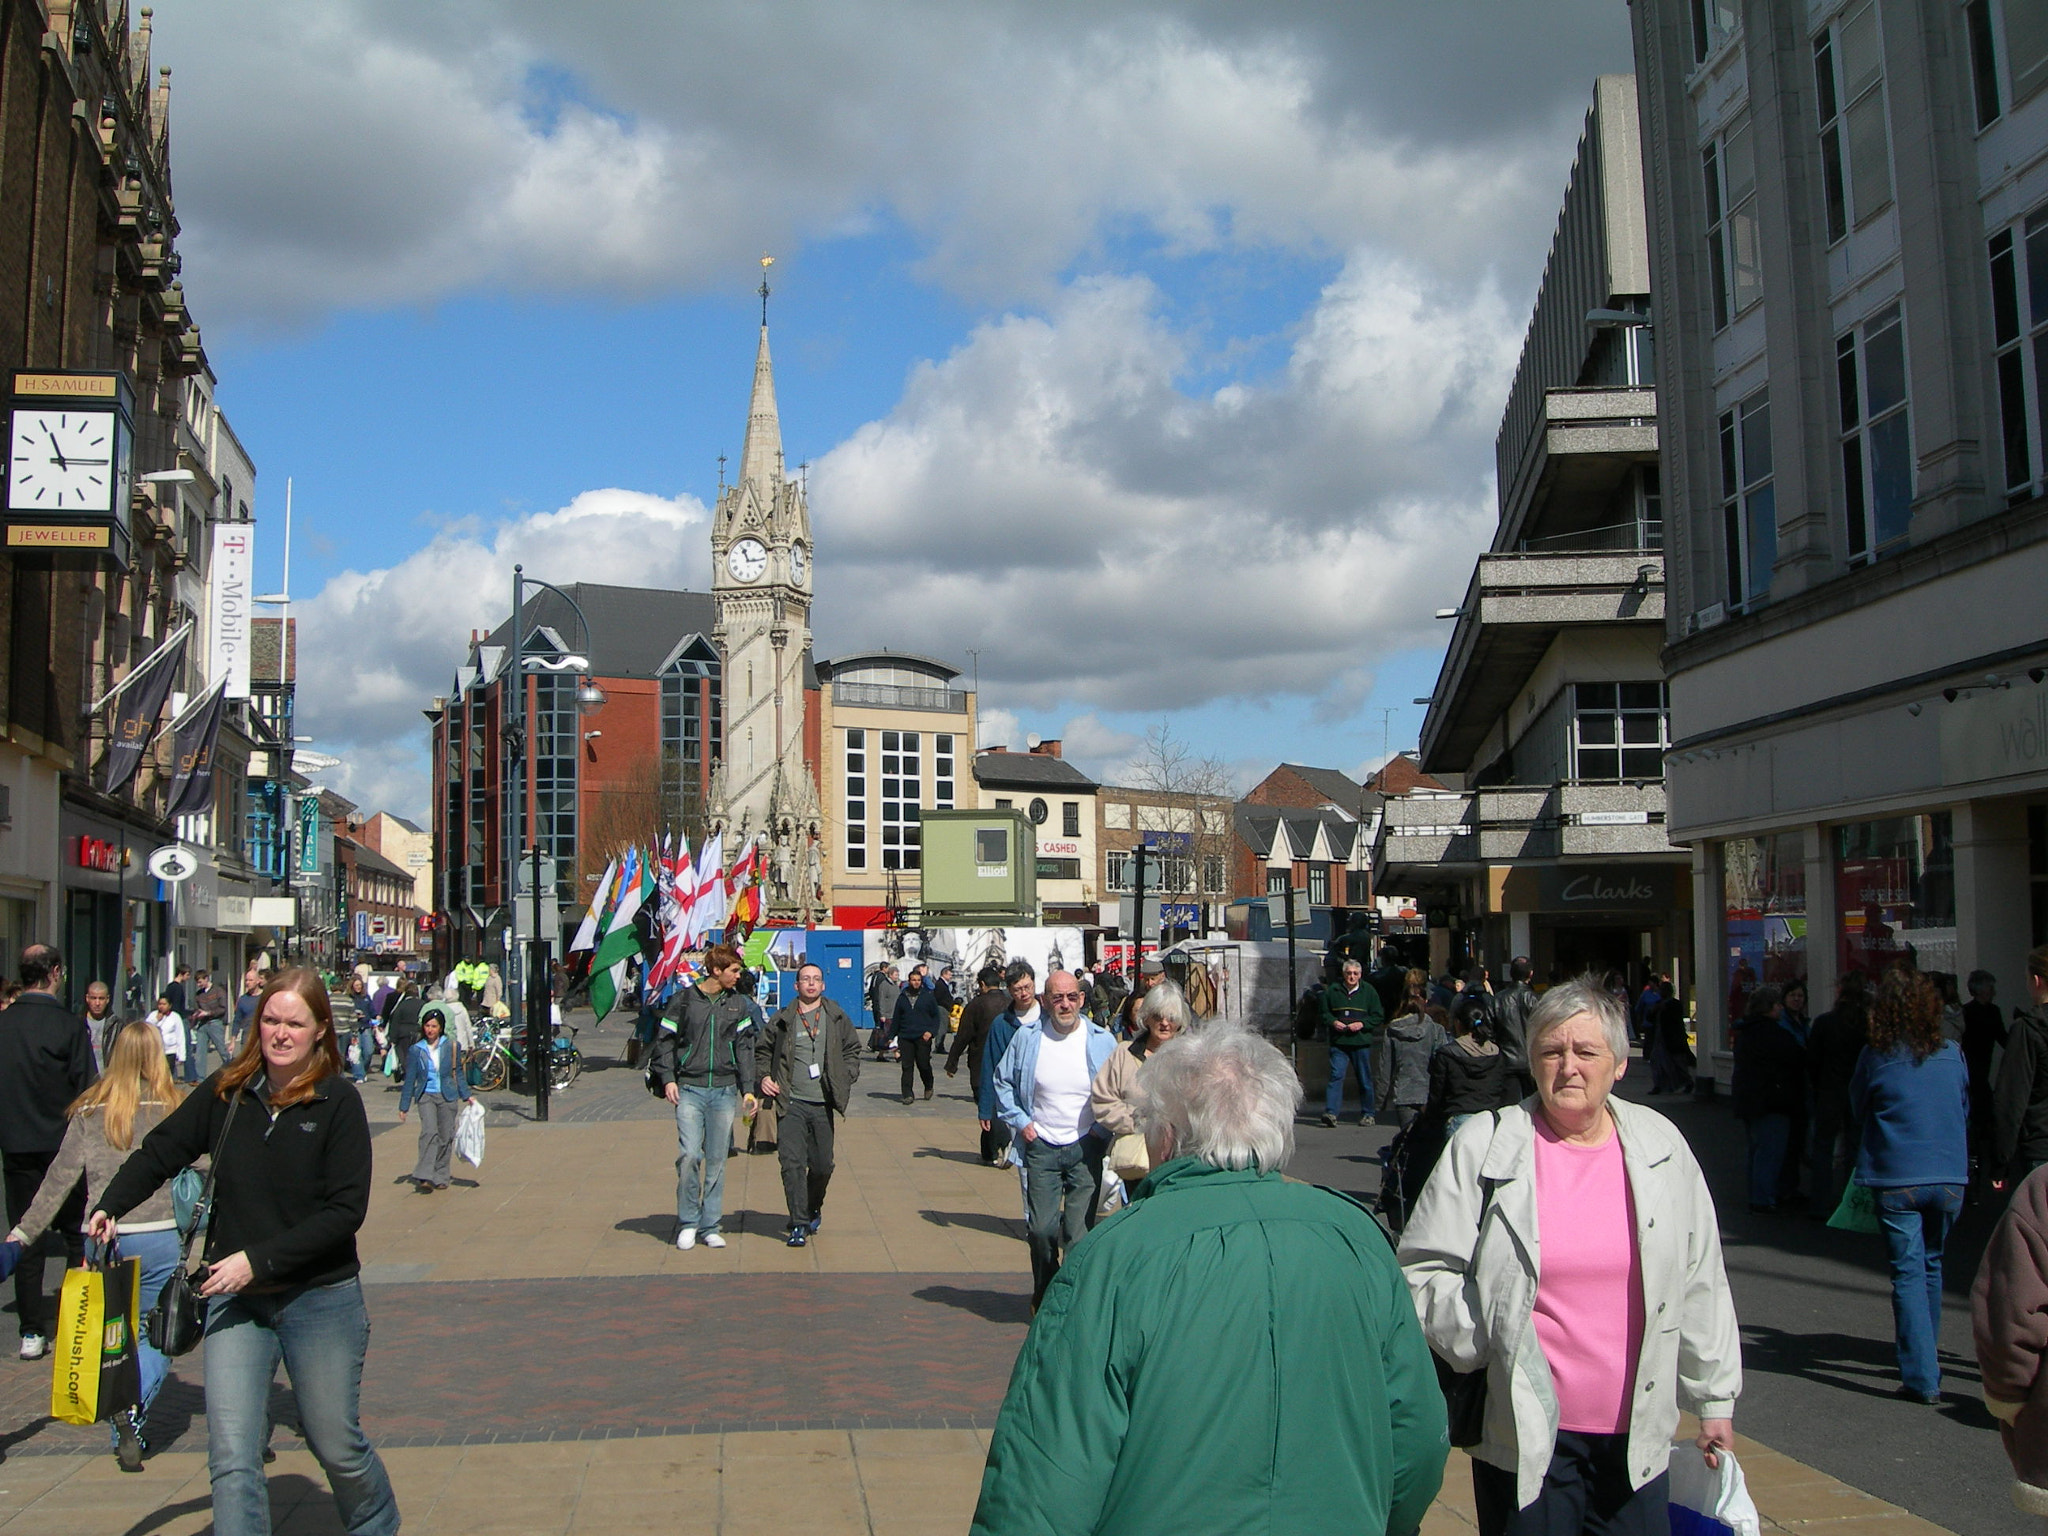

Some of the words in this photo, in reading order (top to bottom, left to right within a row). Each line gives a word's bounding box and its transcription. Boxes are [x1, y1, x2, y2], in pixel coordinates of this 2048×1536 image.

[25, 378, 106, 393] H.SAMUEL
[18, 530, 97, 543] JEWELLER
[1629, 813, 1644, 821] GATE
[1043, 842, 1077, 853] CASHED
[977, 865, 1008, 877] Elliott
[1562, 874, 1654, 901] Clarks
[68, 1285, 90, 1405] www.lush.com
